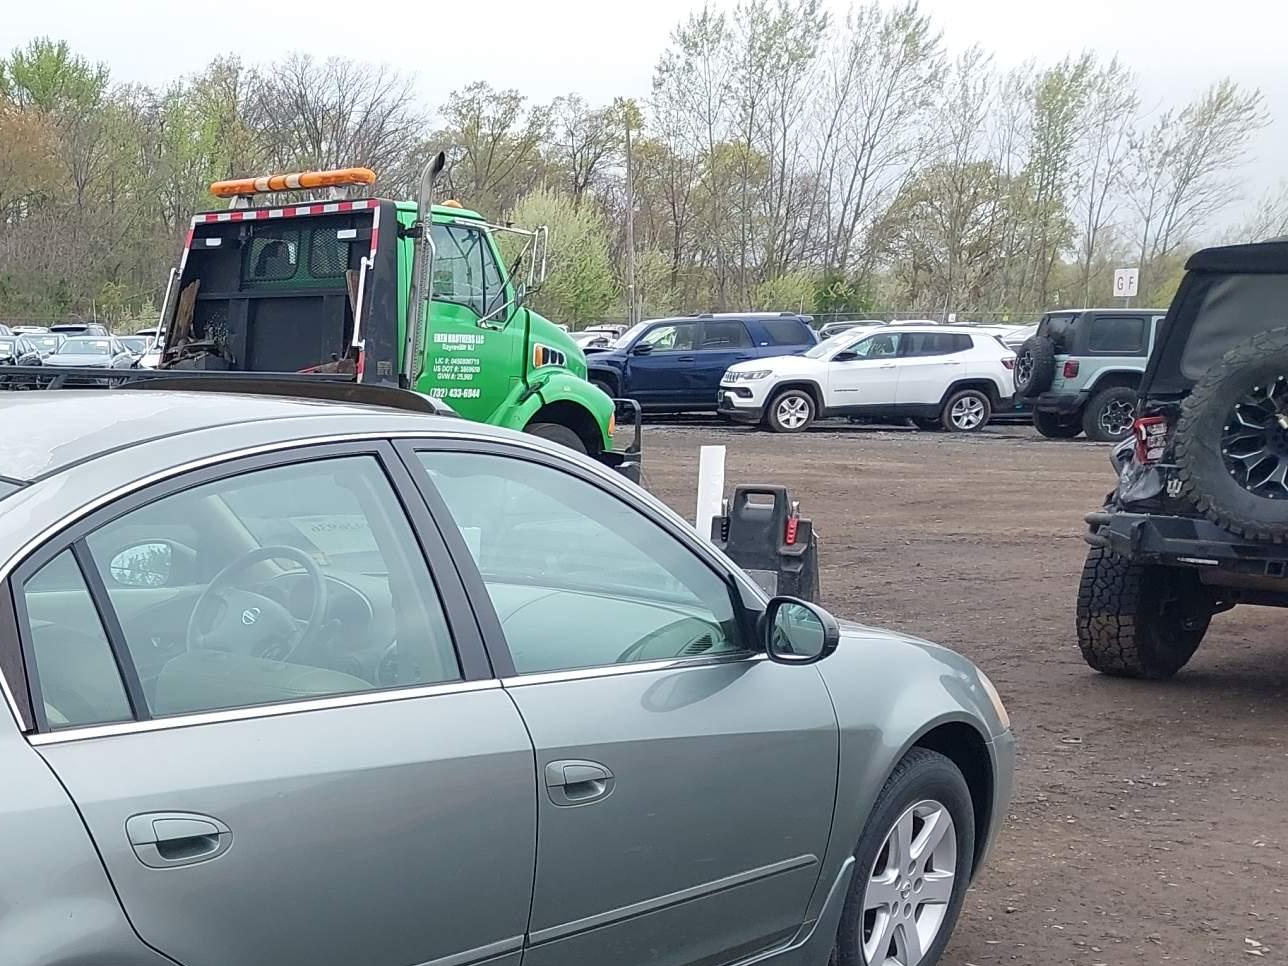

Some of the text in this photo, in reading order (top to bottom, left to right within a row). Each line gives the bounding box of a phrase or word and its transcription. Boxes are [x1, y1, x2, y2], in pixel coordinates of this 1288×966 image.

[1117, 276, 1135, 290] G F
[429, 387, 448, 398] (732)
